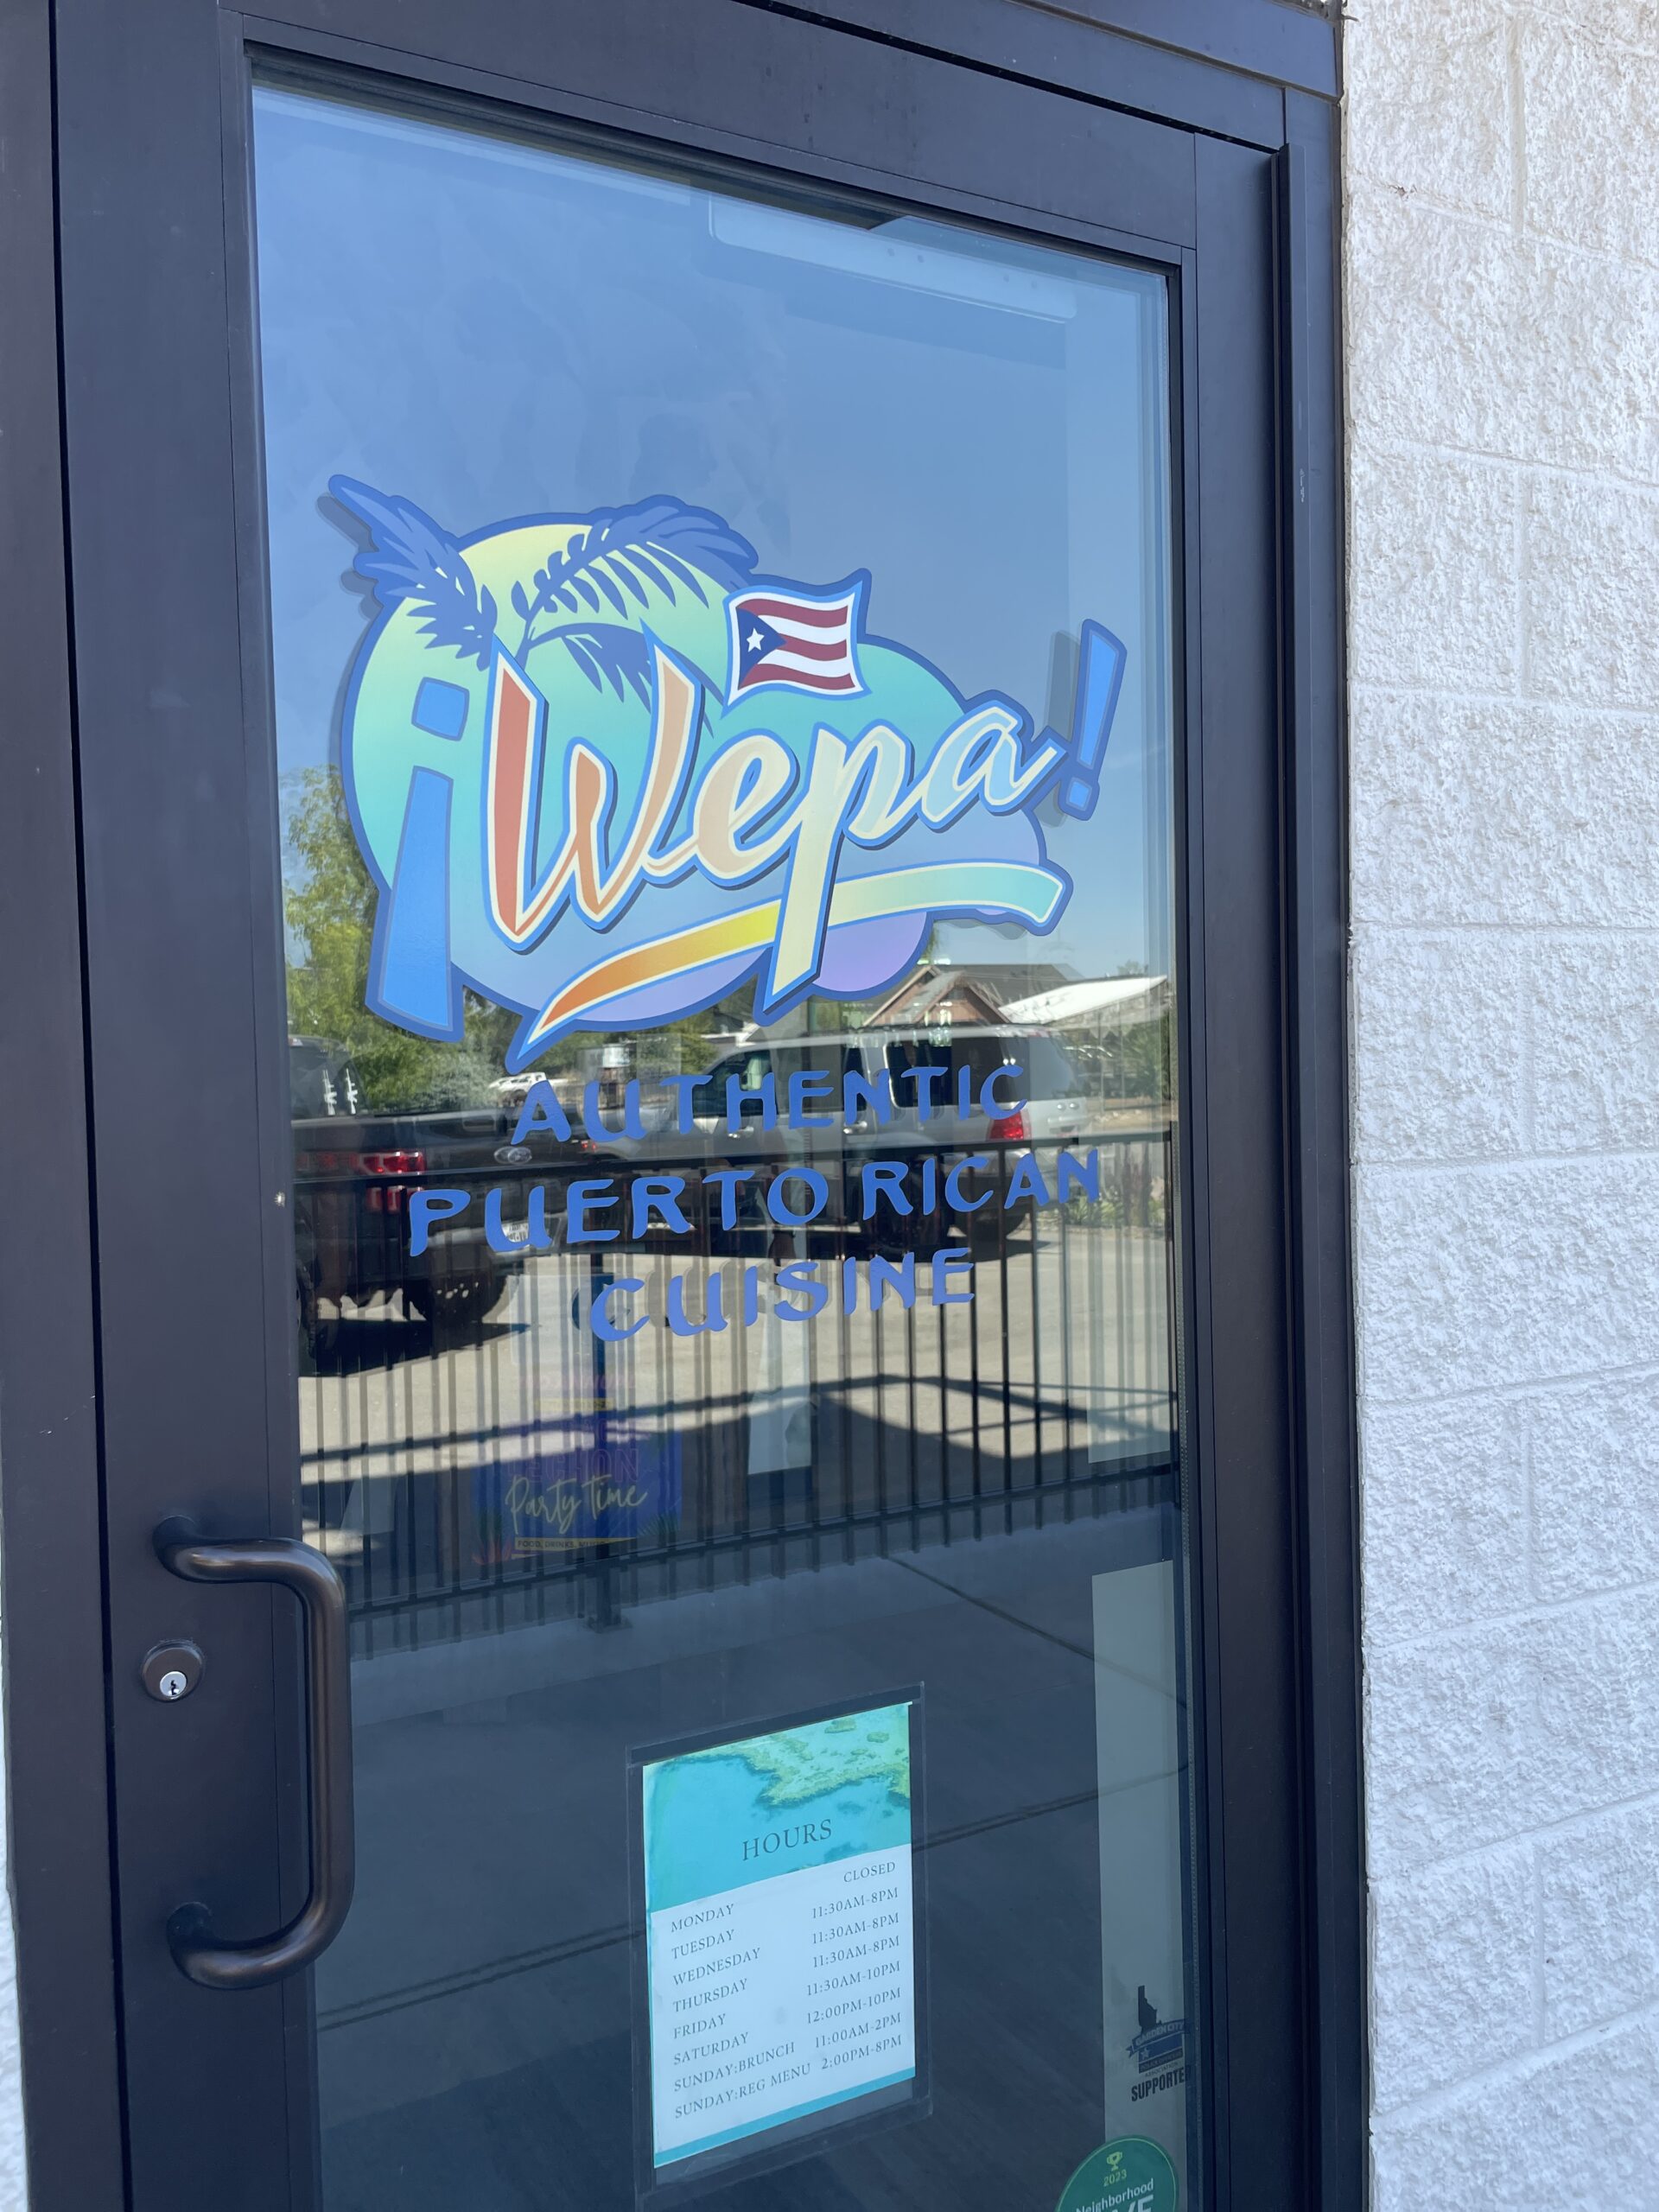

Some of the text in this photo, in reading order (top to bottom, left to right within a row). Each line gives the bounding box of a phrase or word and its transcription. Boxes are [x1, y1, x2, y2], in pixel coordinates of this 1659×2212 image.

[511, 1064, 1029, 1145] AUTHENTIC
[409, 1148, 1100, 1257] PUERTO RICAN
[590, 1246, 976, 1342] CUISINE
[505, 1474, 582, 1535] Party
[742, 1818, 833, 1862] HOURS
[671, 1861, 896, 1933] MONDAY CLOSED
[671, 1887, 899, 1960] TUESDAY 11:30AM-8PM
[672, 1912, 899, 1986] WEDNESDAY 11:30AM-8PM
[672, 1936, 900, 2012] THURSDAY 11:30AM-8PM
[673, 1961, 900, 2039] FRIDAY 11:30AM-10PM
[673, 1987, 901, 2066] SATURDAY 12:00PM-10PM
[674, 2012, 901, 2092] SUNDAY:BRUNCH 11:00AM-2PM
[675, 2035, 902, 2119] SUNDAY:REG MENU 2:00PM-8PM
[1103, 2169, 1128, 2187] 2023
